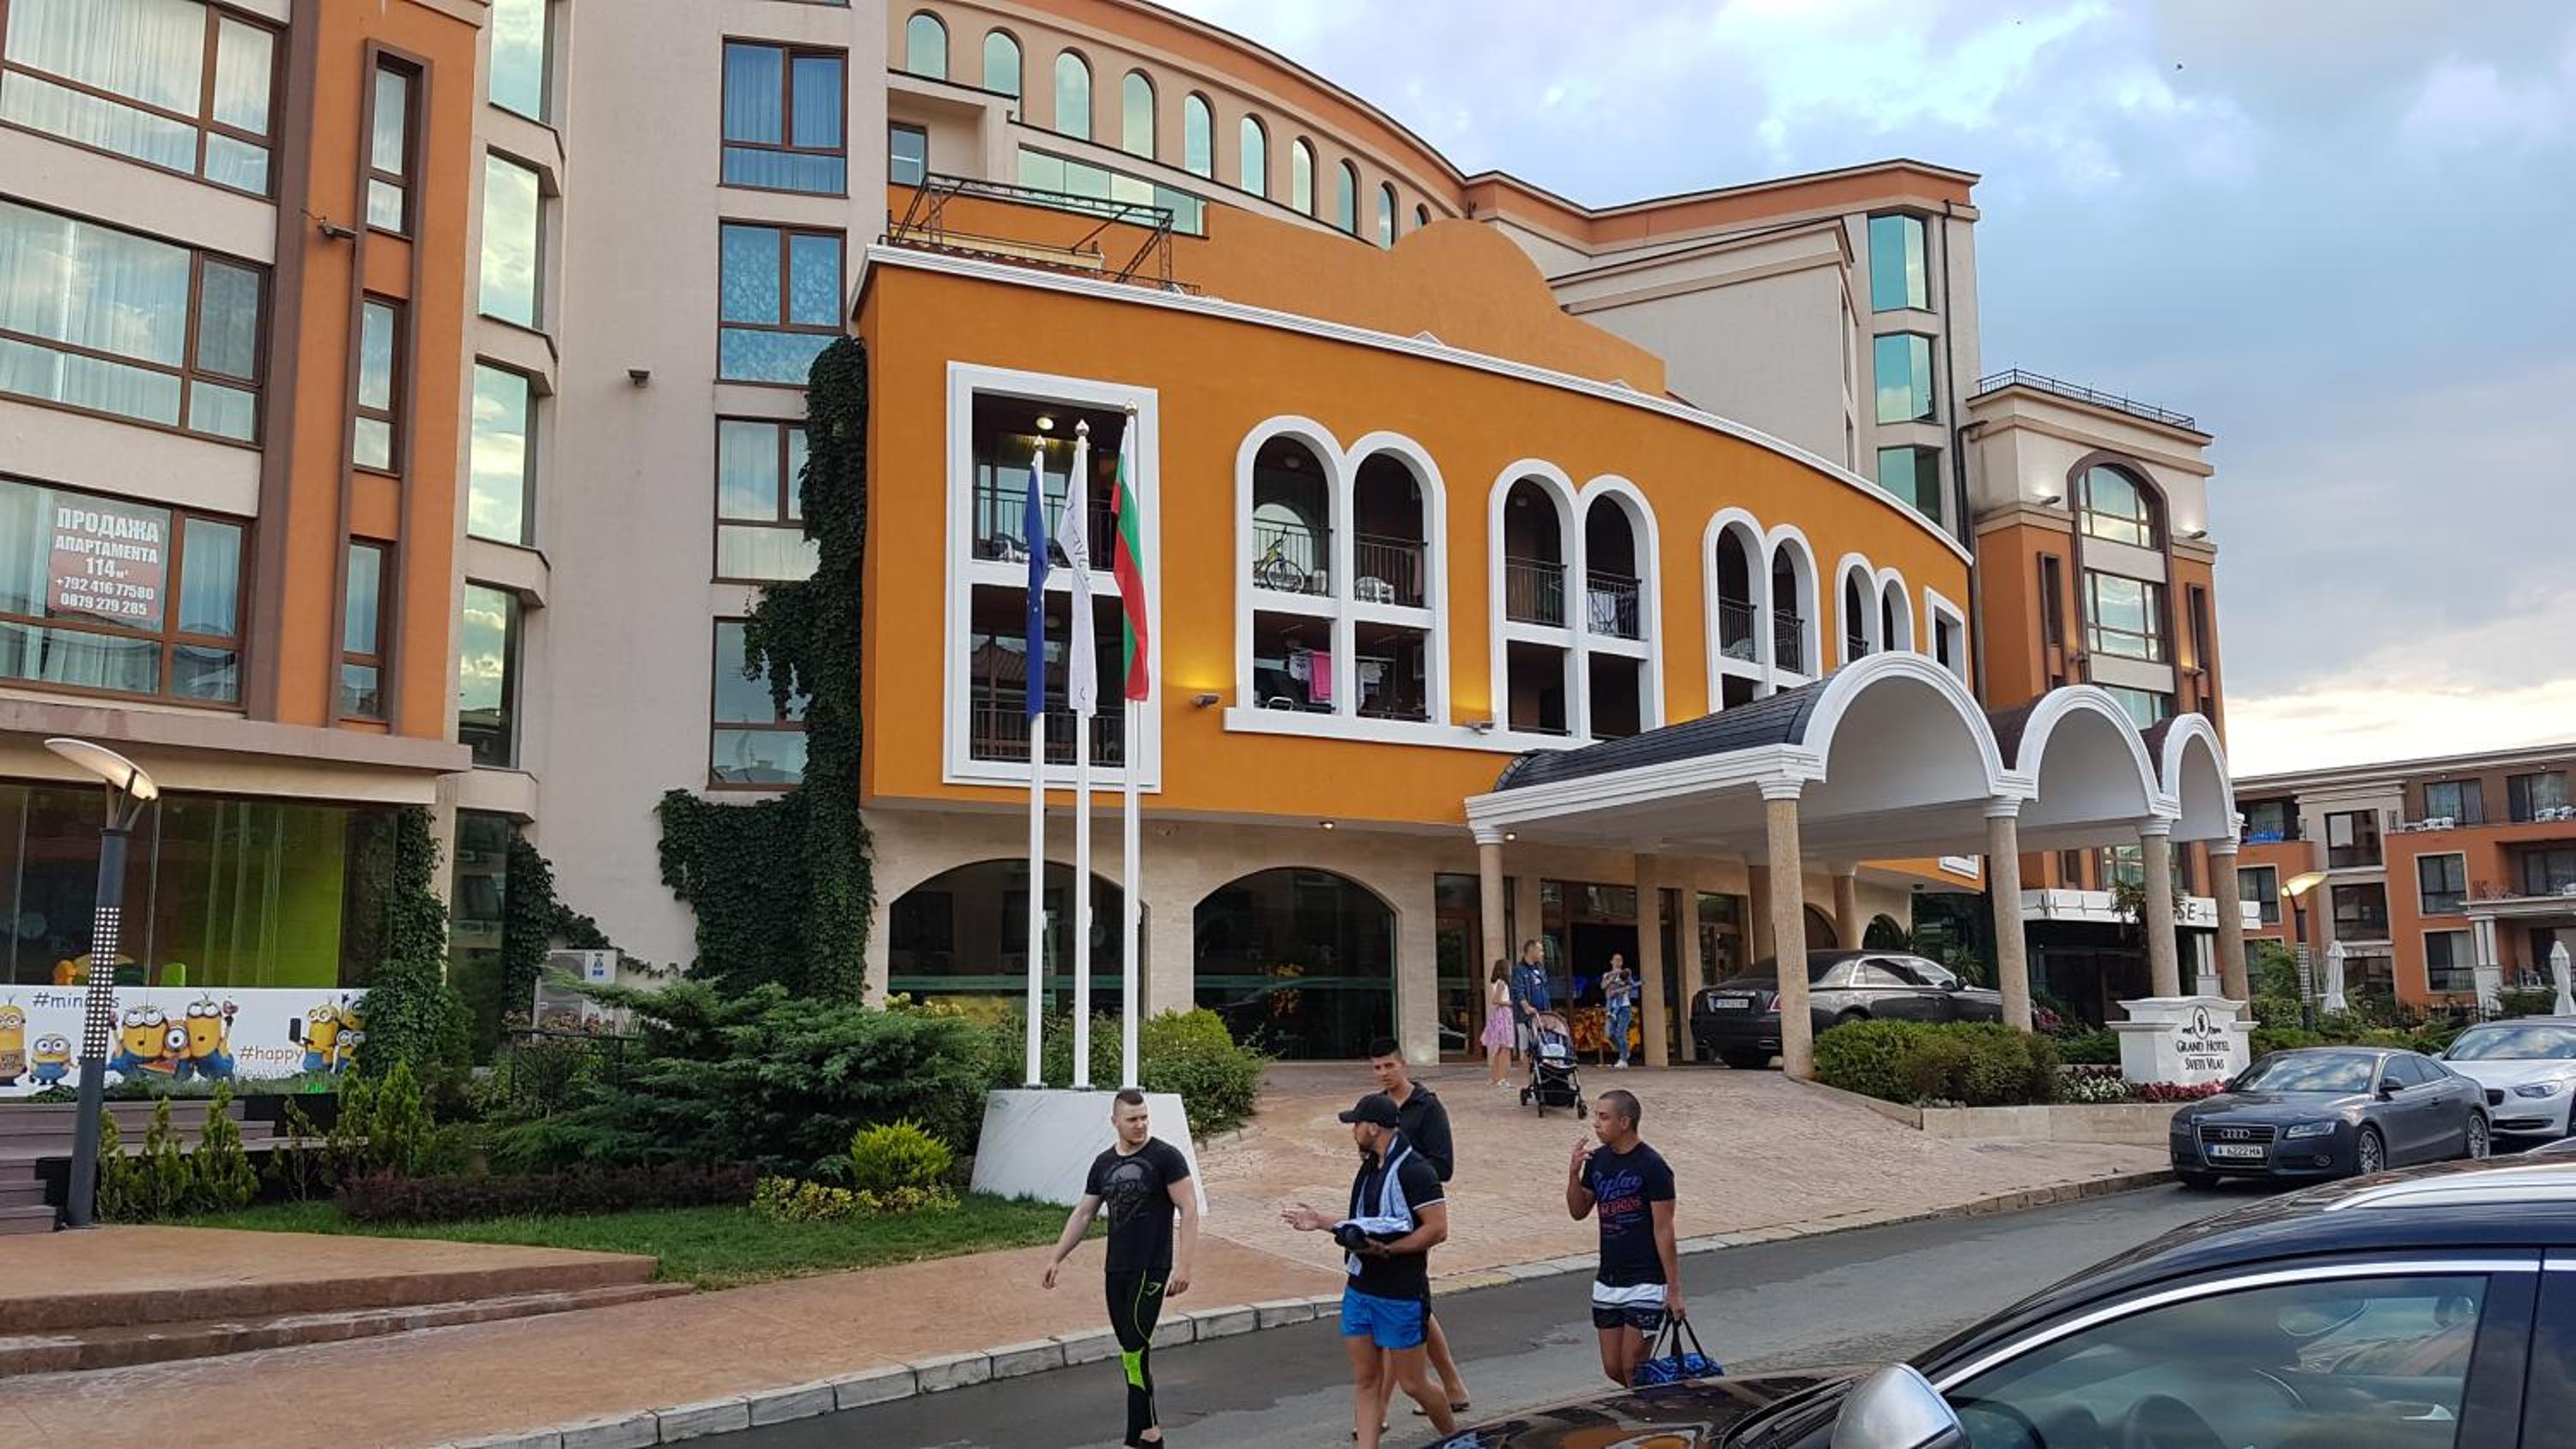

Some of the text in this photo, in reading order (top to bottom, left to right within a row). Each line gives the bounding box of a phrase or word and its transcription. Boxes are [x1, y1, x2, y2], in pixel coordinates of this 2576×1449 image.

[57, 507, 159, 543] ПРОДАЖА
[54, 535, 157, 563] АПАРТАМЕНТА
[90, 580, 112, 595] 416
[122, 601, 147, 615] 285
[2176, 1040, 2230, 1052] GRAND HOTEL
[240, 1046, 304, 1064] #happy
[2184, 1057, 2225, 1070] SVETI VLAS
